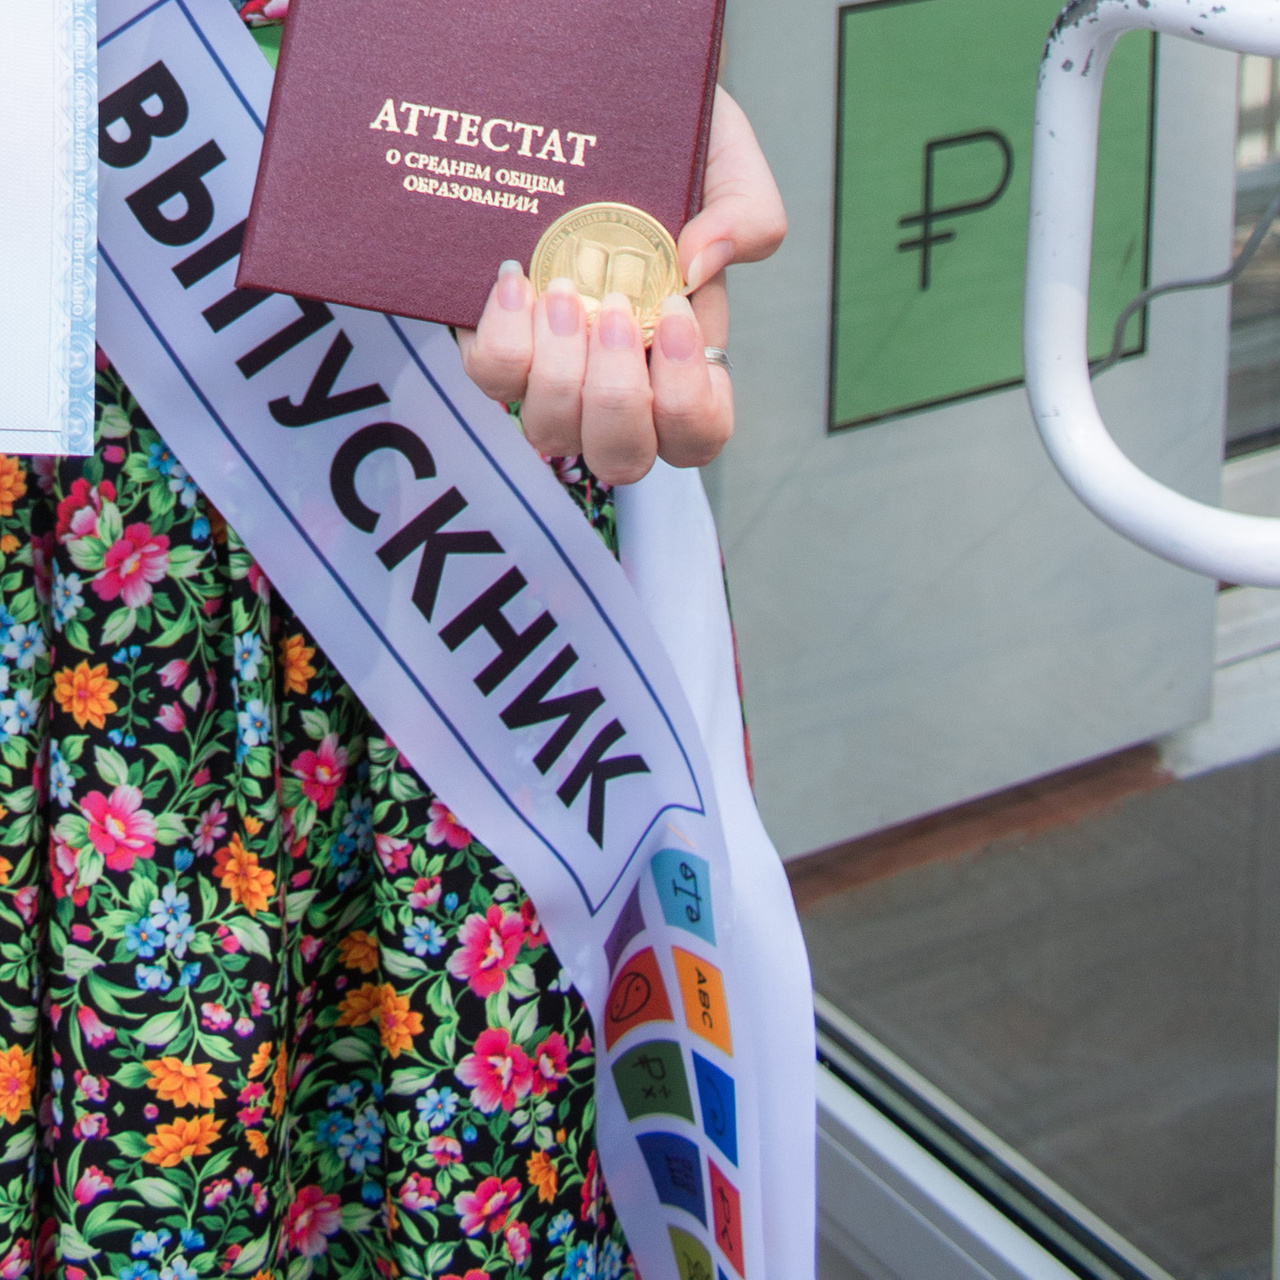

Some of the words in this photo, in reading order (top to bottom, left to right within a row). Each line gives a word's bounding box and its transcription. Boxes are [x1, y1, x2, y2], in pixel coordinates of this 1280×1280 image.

[369, 98, 597, 167] АТТЕСТАТ
[386, 149, 401, 166] О
[405, 152, 491, 182] СРЕДНЕМ
[495, 168, 565, 196] ОБЩЕМ
[403, 175, 539, 214] ОБРАЗОВАНИИ
[99, 59, 652, 851] ВЫПУСКНИК
